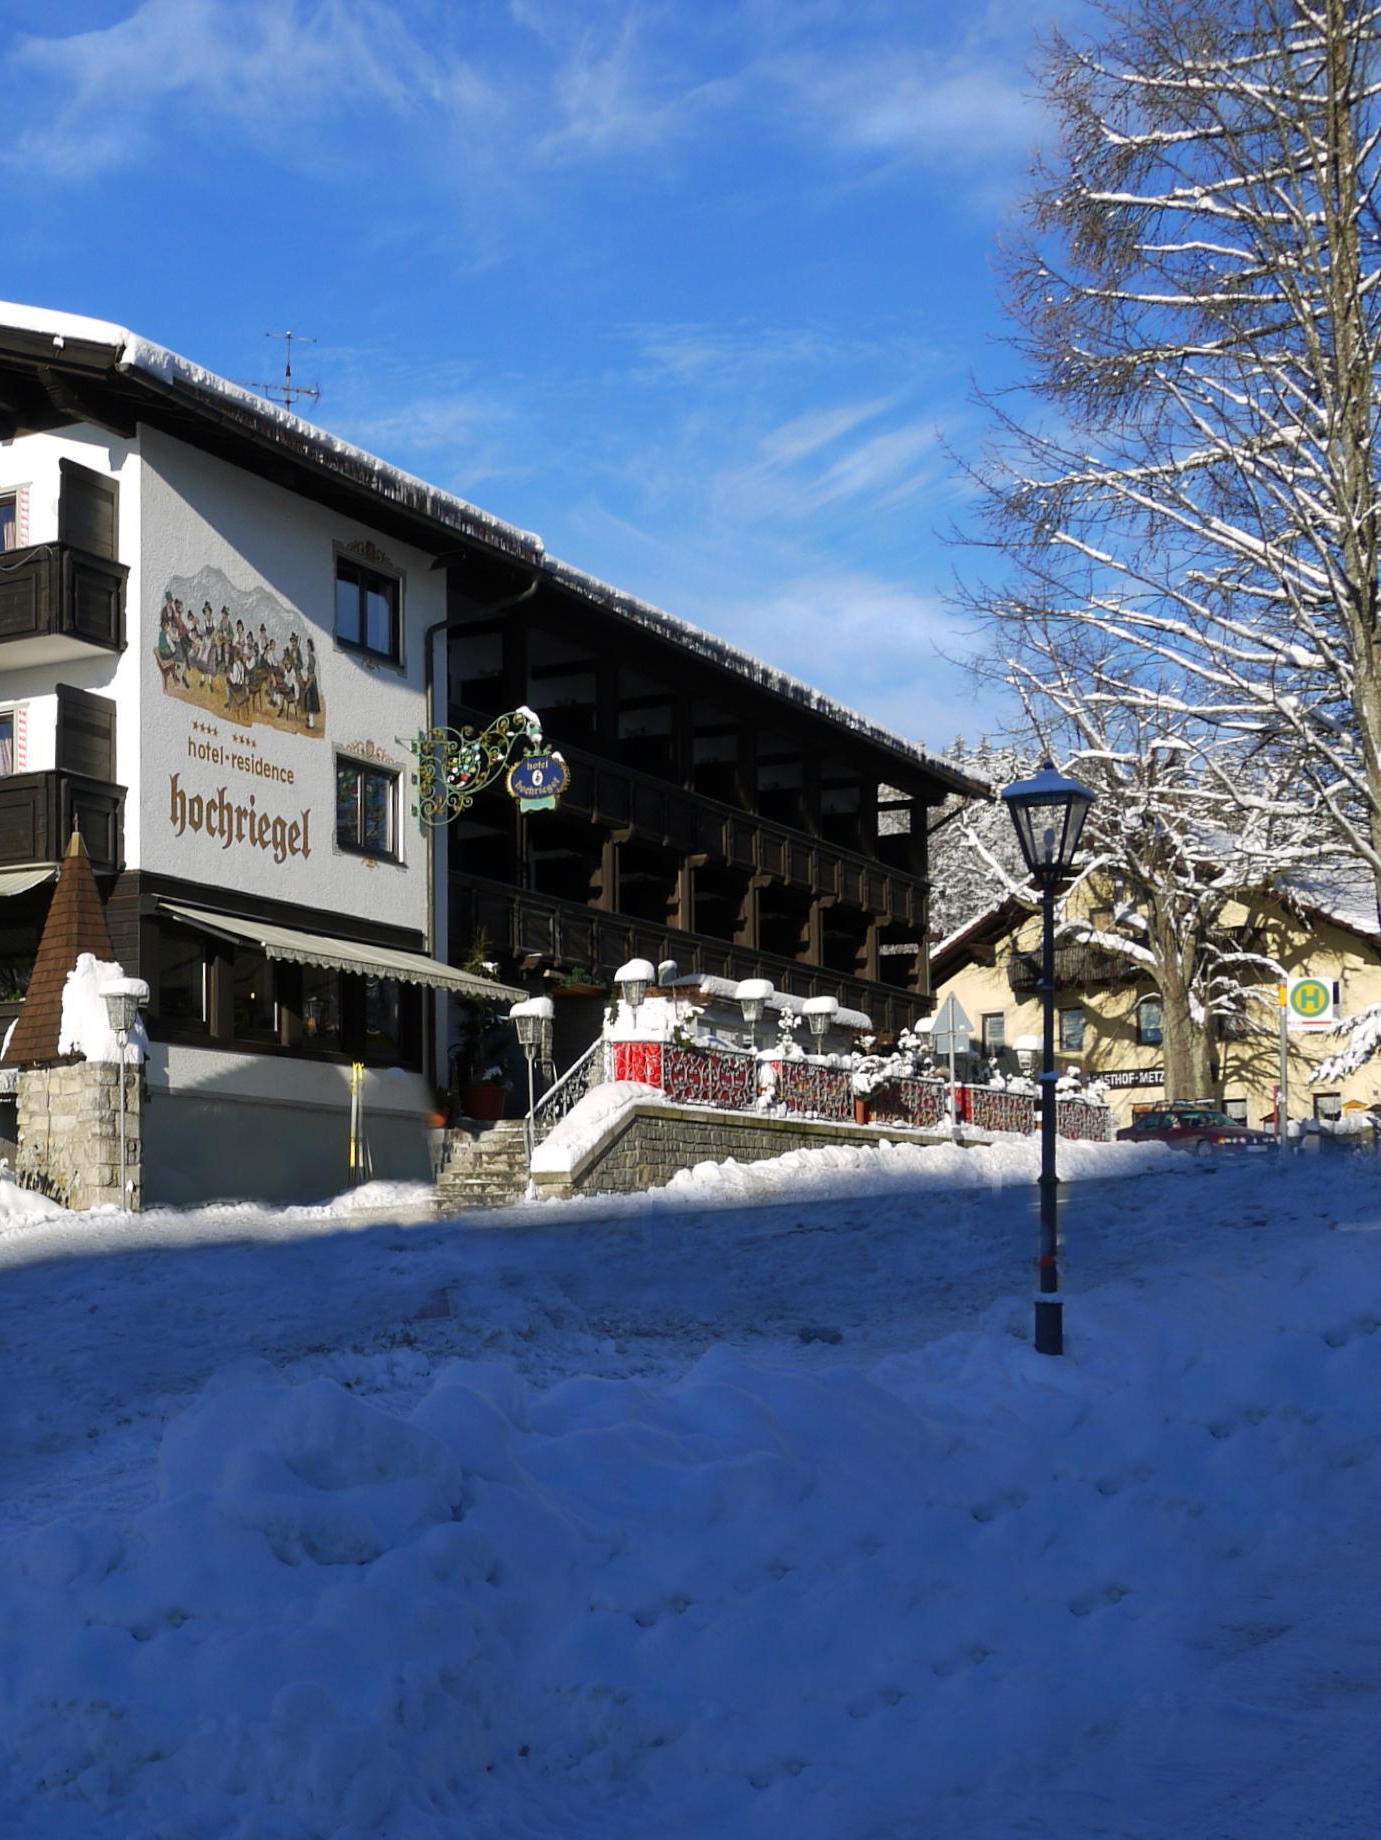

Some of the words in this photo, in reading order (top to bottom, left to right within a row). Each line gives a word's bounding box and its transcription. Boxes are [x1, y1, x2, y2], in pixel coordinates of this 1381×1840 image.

[188, 736, 295, 785] hotel-residence
[526, 760, 549, 771] hotel
[169, 772, 312, 865] hochriegel
[1301, 989, 1320, 1009] H
